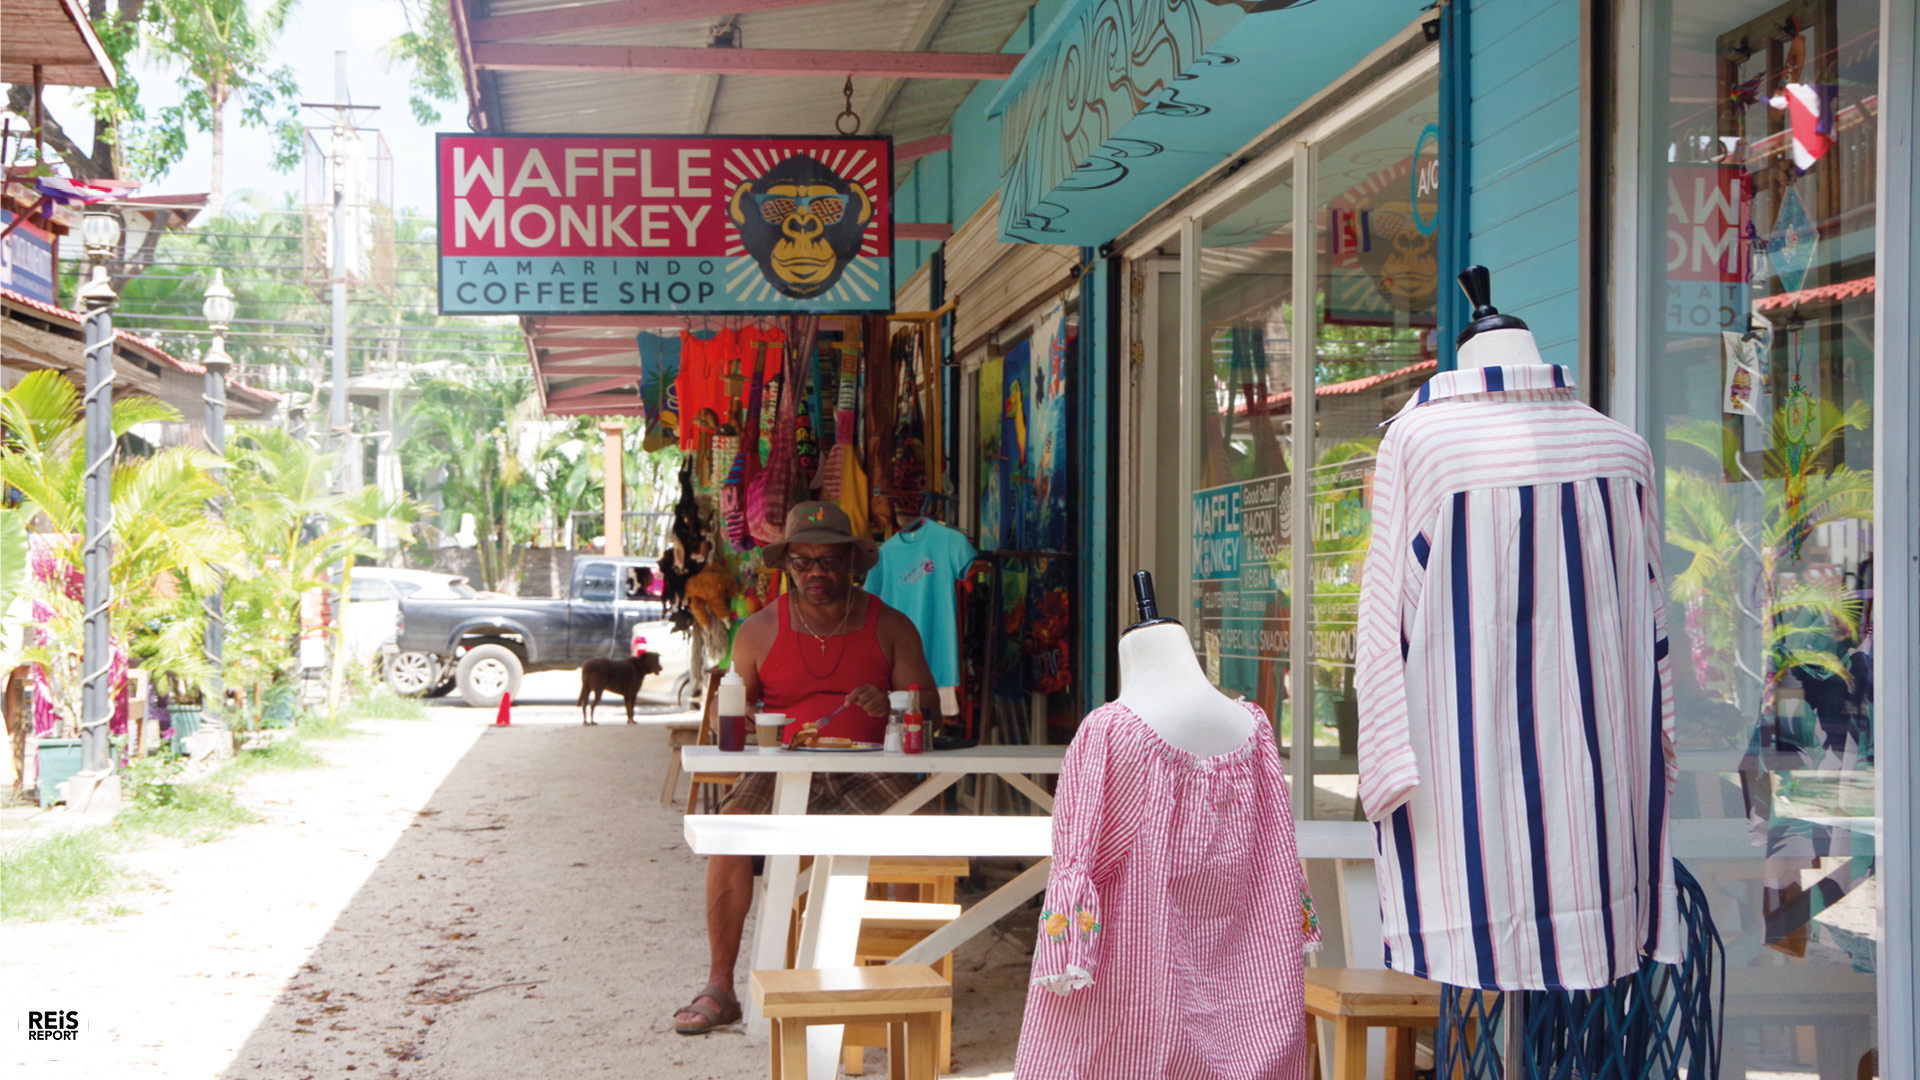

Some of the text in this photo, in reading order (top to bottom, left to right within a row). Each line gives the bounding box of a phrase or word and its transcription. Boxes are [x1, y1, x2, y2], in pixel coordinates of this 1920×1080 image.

[452, 147, 712, 198] WAFFLE
[453, 198, 712, 248] MONKEY
[456, 260, 714, 276] TAMARINDO
[456, 281, 714, 305] COFFEE SHOP
[1243, 485, 1259, 506] Good
[1192, 491, 1240, 535] WAFFLE
[1243, 510, 1272, 536] BACON
[1254, 536, 1276, 559] EGGS
[1244, 566, 1269, 588] VEGAN
[1226, 629, 1257, 649] SPECIALS
[1259, 630, 1289, 652] SNACKS
